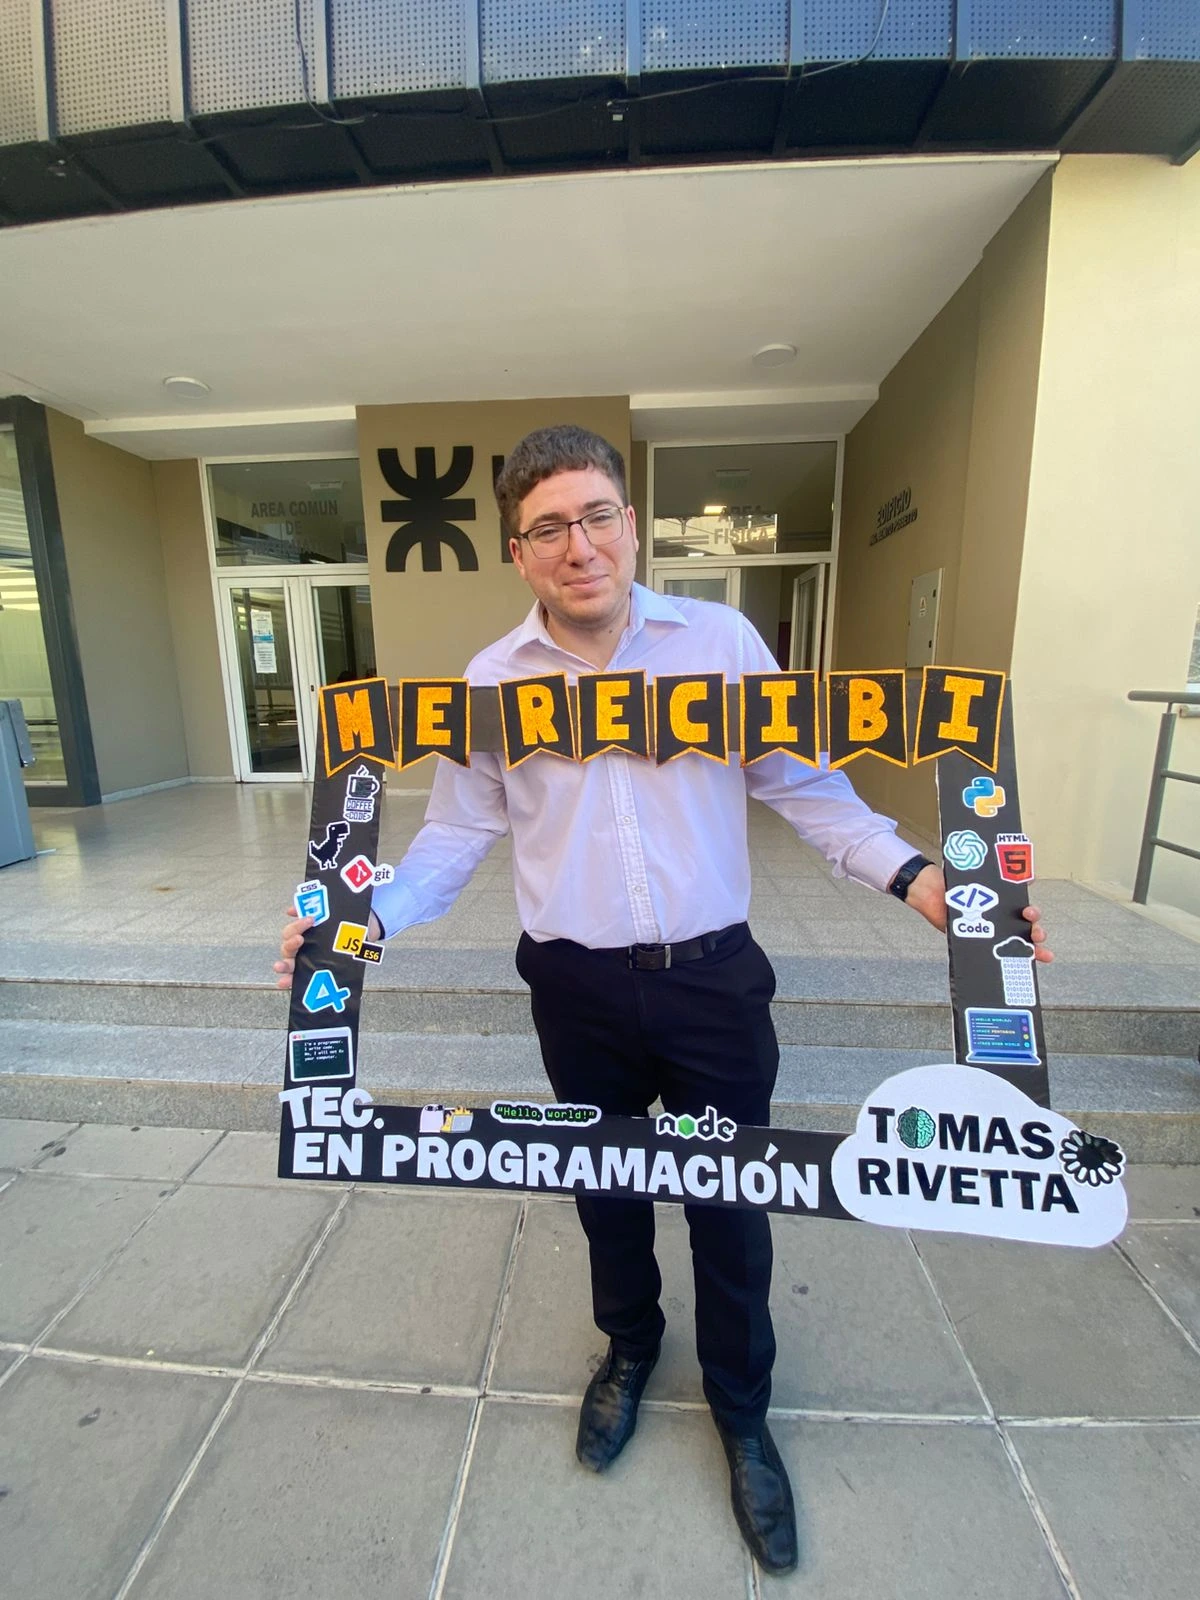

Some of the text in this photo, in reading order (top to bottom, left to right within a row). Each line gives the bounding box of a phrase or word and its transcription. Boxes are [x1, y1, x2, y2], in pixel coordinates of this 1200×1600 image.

[251, 500, 338, 518] AREA COMUN
[285, 520, 303, 535] DE
[714, 527, 769, 545] FISICA
[334, 675, 985, 752] ME RECIBI
[999, 834, 1029, 842] HTML
[374, 868, 390, 882] git
[957, 923, 990, 933] Code
[342, 937, 361, 952] JS
[363, 949, 380, 961] ES6
[278, 1085, 385, 1130] TEC.
[658, 1107, 736, 1141] node
[292, 1132, 819, 1209] EN PROGRAMACIÓN
[858, 1157, 1080, 1214] RIVETTA
